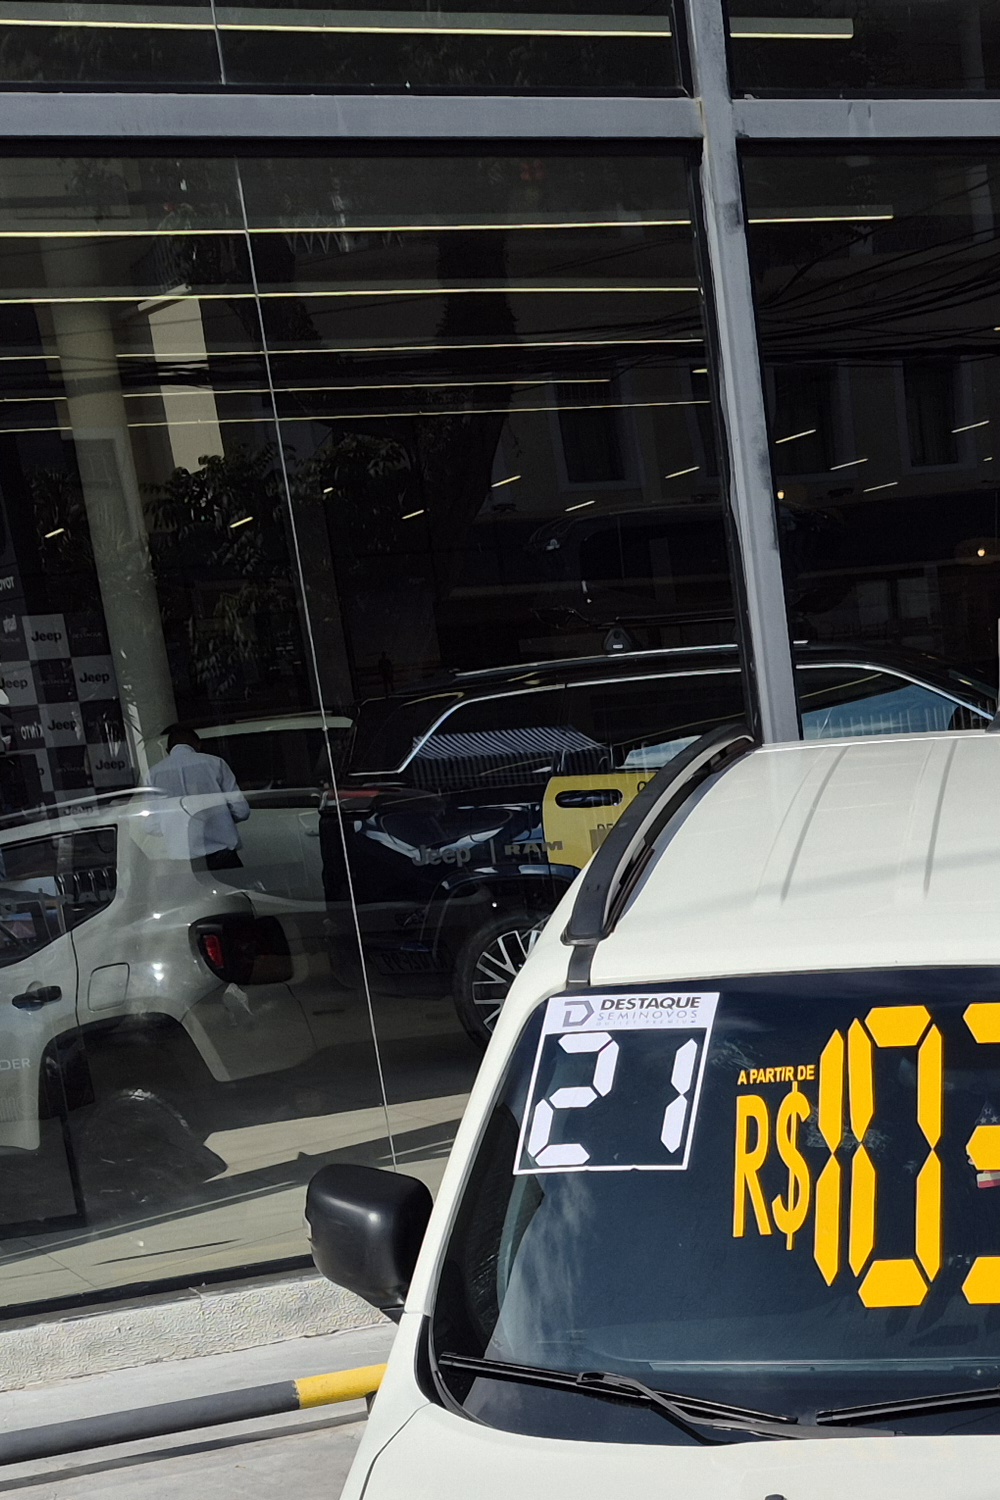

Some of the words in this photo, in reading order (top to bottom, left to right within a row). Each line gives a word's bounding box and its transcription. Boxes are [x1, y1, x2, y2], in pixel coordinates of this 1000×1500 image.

[31, 631, 62, 643] Jeep
[79, 672, 110, 683] Jeep
[95, 760, 126, 771] Jeep
[411, 844, 471, 867] Jeep
[504, 840, 563, 856] RAM
[600, 996, 702, 1011] DESTAQUE
[597, 1009, 698, 1021] SEMINOVOS
[737, 1069, 748, 1085] A
[749, 1065, 795, 1084] PARTIR
[796, 1064, 817, 1081] DE
[528, 1032, 698, 1167] 21
